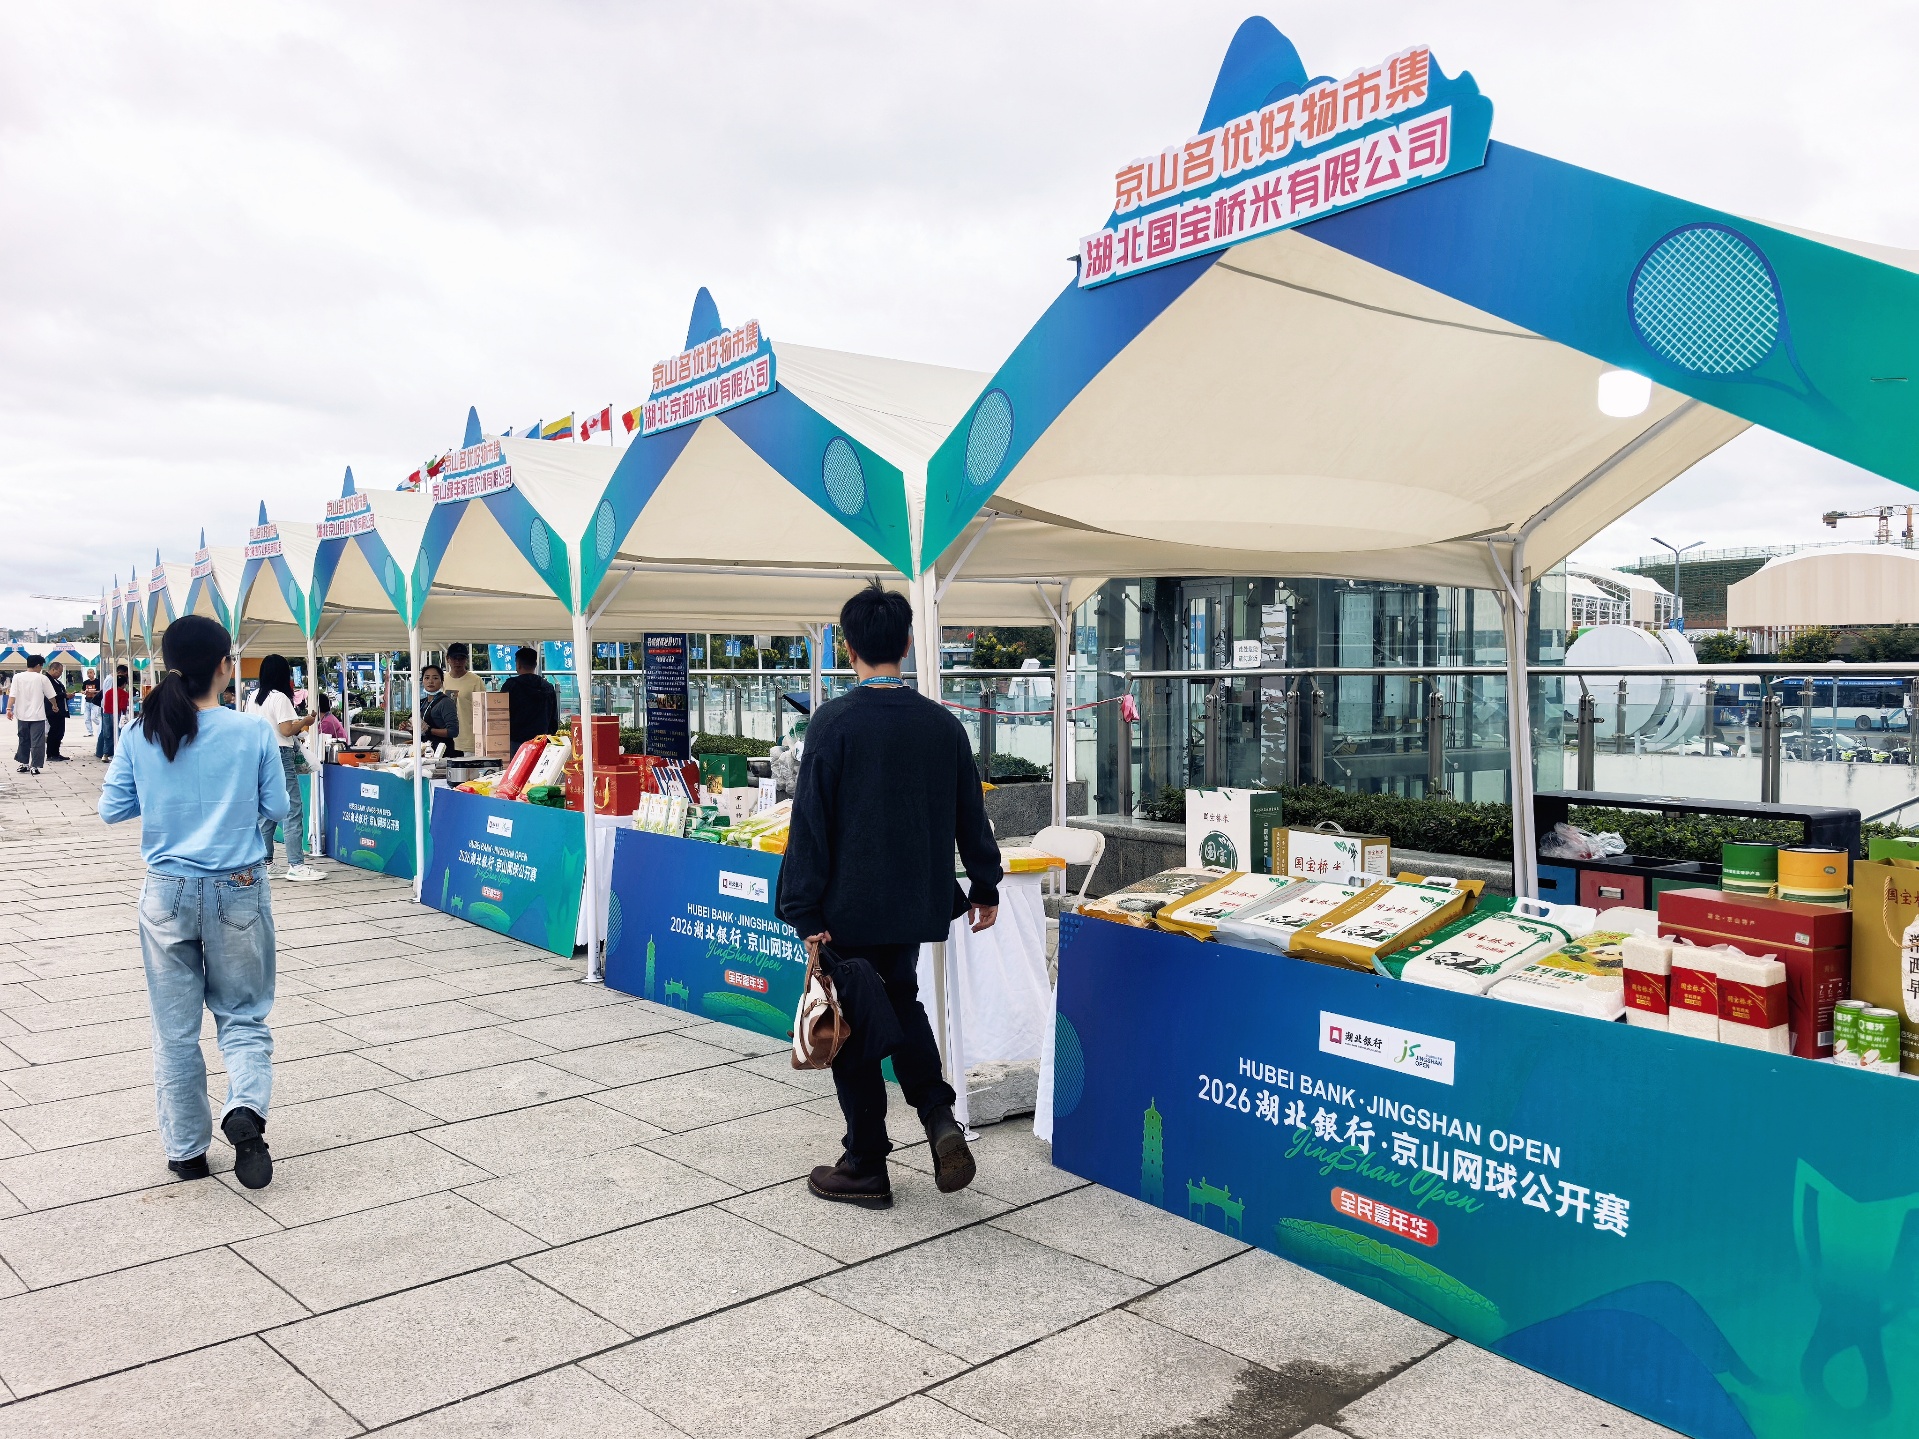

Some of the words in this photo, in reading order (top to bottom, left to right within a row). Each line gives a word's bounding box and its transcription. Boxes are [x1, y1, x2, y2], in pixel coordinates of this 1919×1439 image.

[1115, 48, 1430, 209] 京山名优好物市集
[1085, 115, 1449, 279] 湖北国宝桥米有限公司
[652, 321, 758, 390] 京山名优好物市集
[644, 359, 768, 430] 湖北京和米业有限公司
[1294, 856, 1342, 875] 国宝桥米
[687, 903, 710, 918] HUBEI
[782, 924, 800, 939] OPE
[1239, 1056, 1294, 1090] HUBEI
[1489, 1129, 1561, 1168] OPEN
[1284, 1126, 1408, 1188] JingShan
[1409, 1170, 1484, 1214] Open
[1340, 1190, 1428, 1239] 全民嘉年华
